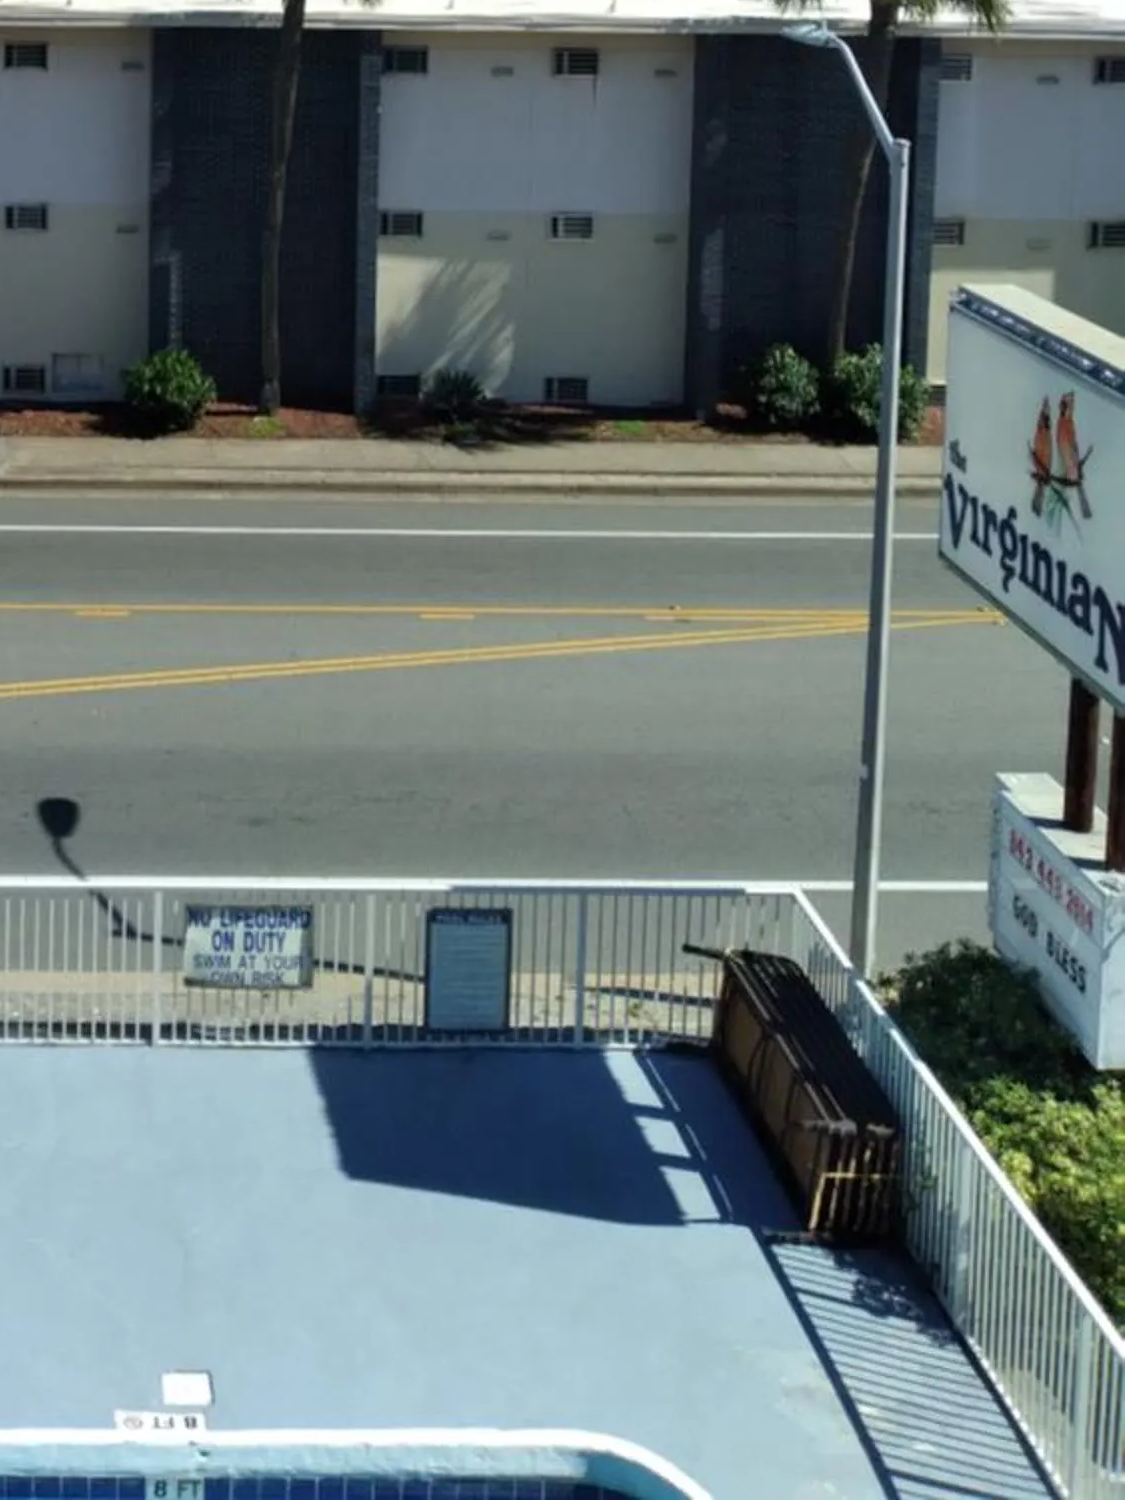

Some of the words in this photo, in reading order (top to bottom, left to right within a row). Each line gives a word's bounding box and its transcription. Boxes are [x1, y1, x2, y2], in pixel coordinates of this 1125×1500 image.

[949, 438, 967, 474] the
[211, 930, 235, 952] ON
[243, 931, 286, 953] DUTY
[1013, 894, 1038, 938] GOD
[1046, 930, 1087, 996] BLESS
[193, 954, 232, 970] SWIM
[238, 955, 257, 969] AT
[154, 1480, 167, 1498] 8
[177, 1479, 202, 1499] FT
